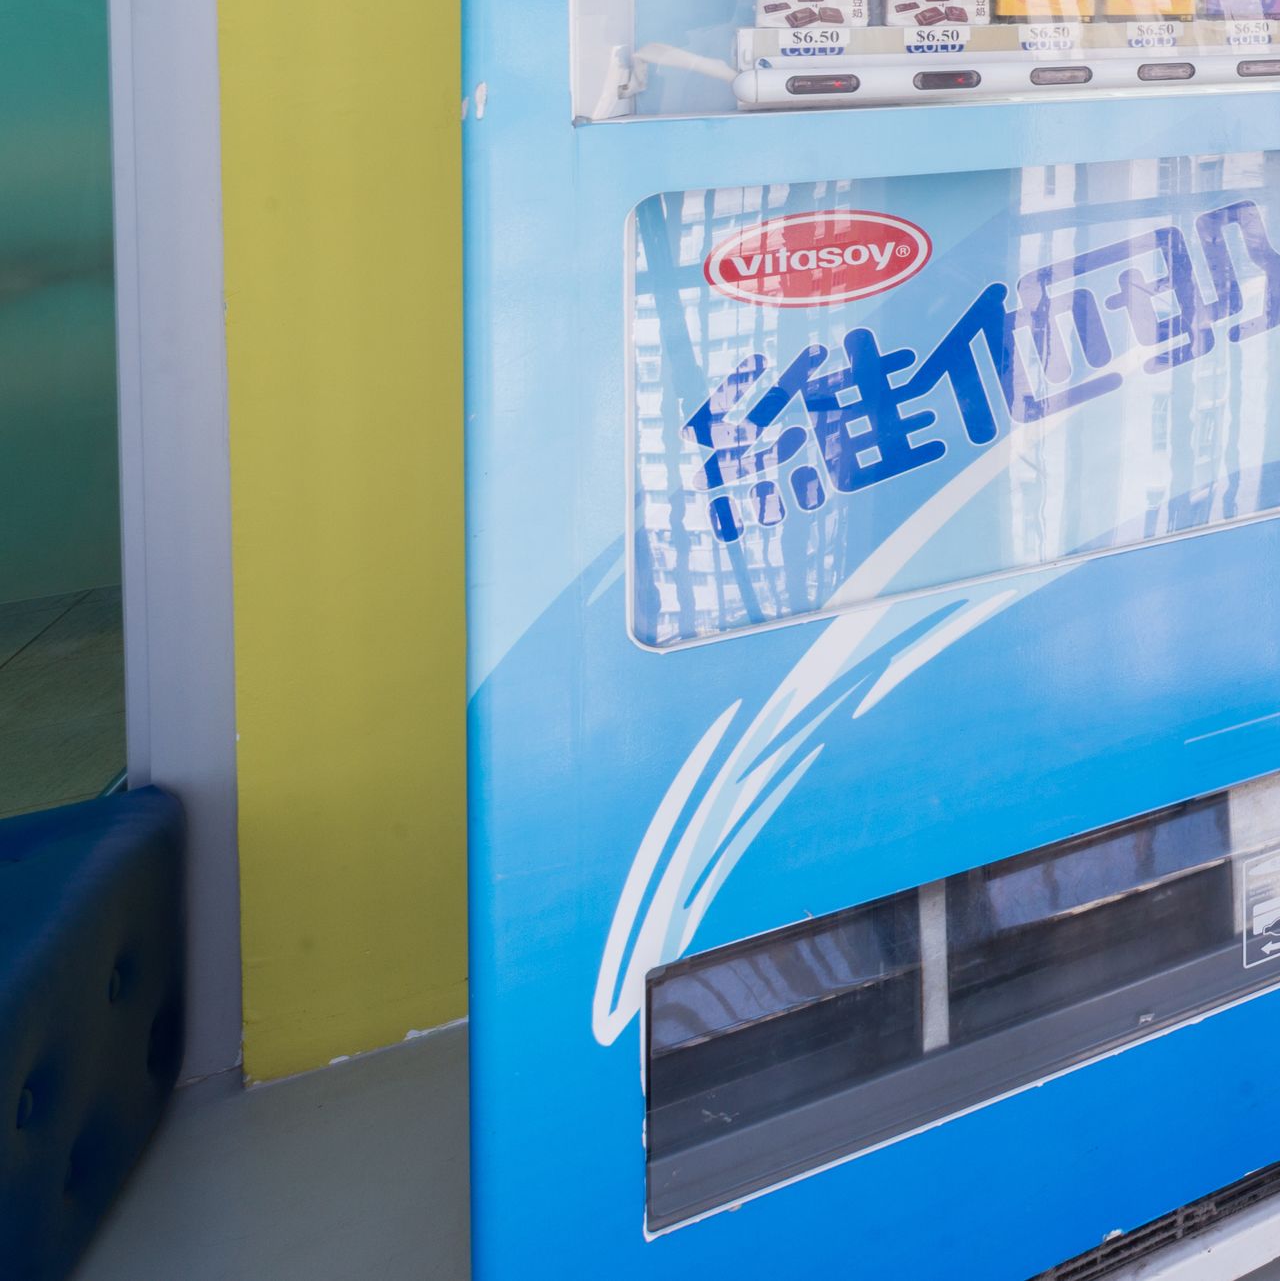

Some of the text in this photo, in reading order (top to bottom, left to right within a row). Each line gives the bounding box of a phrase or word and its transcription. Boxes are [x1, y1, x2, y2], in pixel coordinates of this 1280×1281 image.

[1029, 26, 1070, 40] $6.50
[1136, 23, 1175, 37] $6.50
[1234, 22, 1270, 34] $6.50
[792, 29, 841, 45] $6.50
[916, 28, 961, 43] $6.50
[731, 237, 894, 278] Vitasoy
